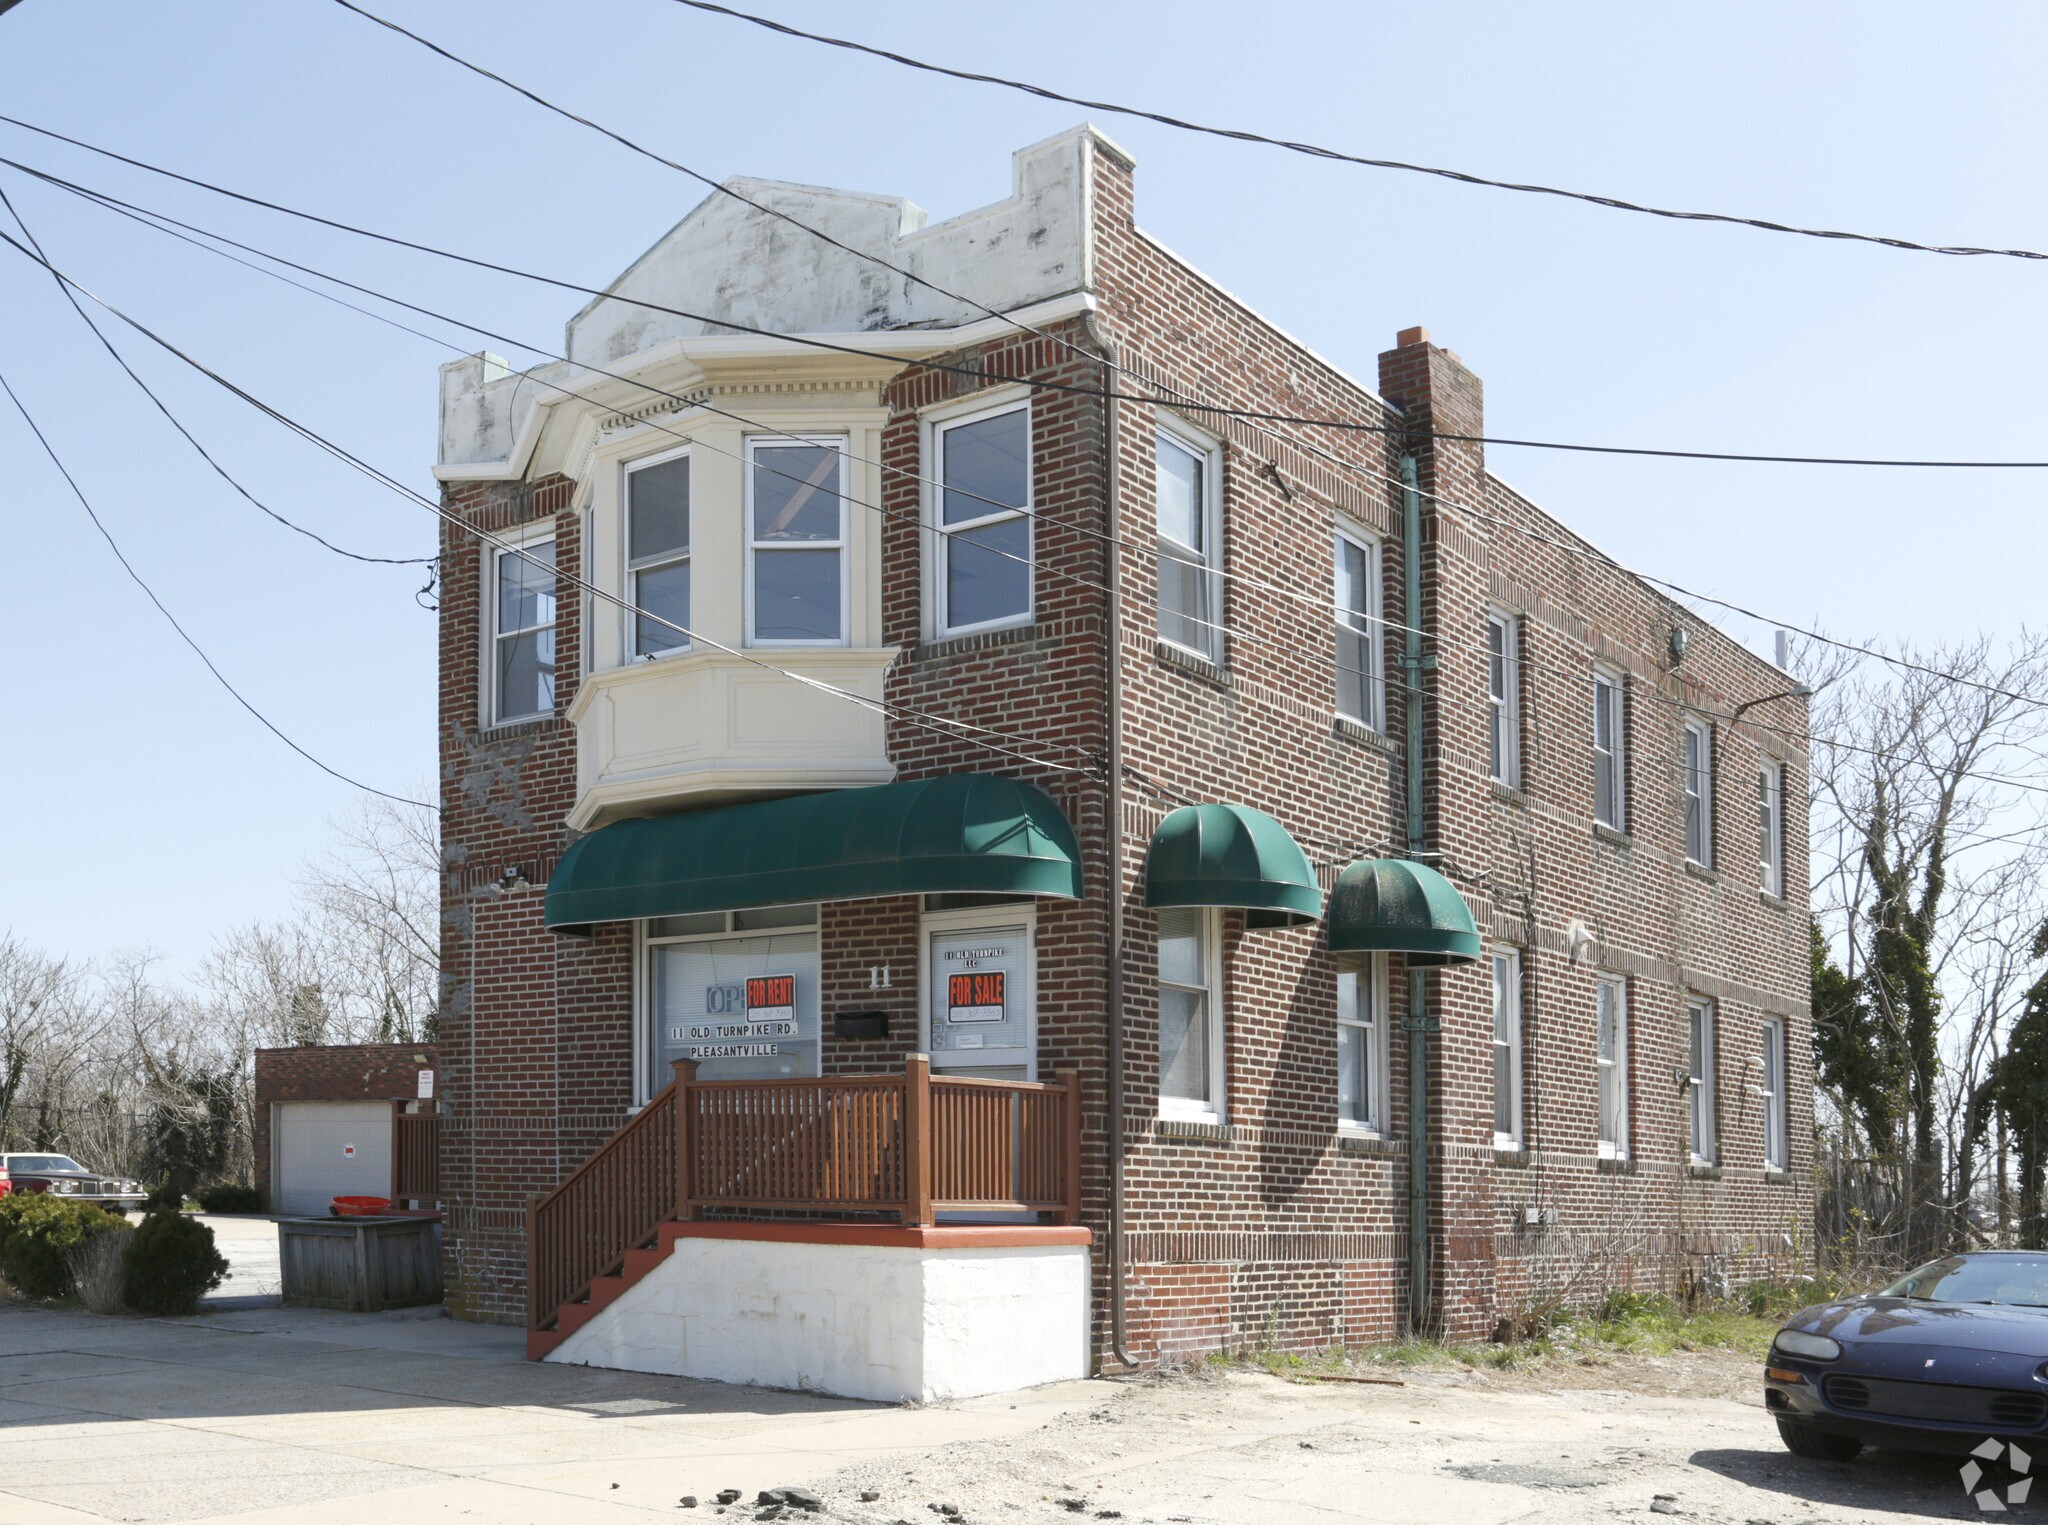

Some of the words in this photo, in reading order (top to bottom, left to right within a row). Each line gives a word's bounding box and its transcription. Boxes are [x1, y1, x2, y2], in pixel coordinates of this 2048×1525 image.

[956, 951, 969, 959] OLD
[972, 948, 1003, 958] TURNPIKE
[964, 960, 977, 968] LLC
[869, 965, 893, 989] 11
[707, 987, 746, 1013] OP
[747, 980, 766, 1007] FOR
[768, 977, 793, 1005] RENT
[950, 976, 971, 1006] FOR
[975, 975, 1003, 1005] SALE
[691, 1027, 710, 1038] OLD
[716, 1024, 770, 1037] TURNPIKE
[777, 1023, 796, 1035] RD.
[691, 1044, 777, 1058] PLEASANTVILLE
